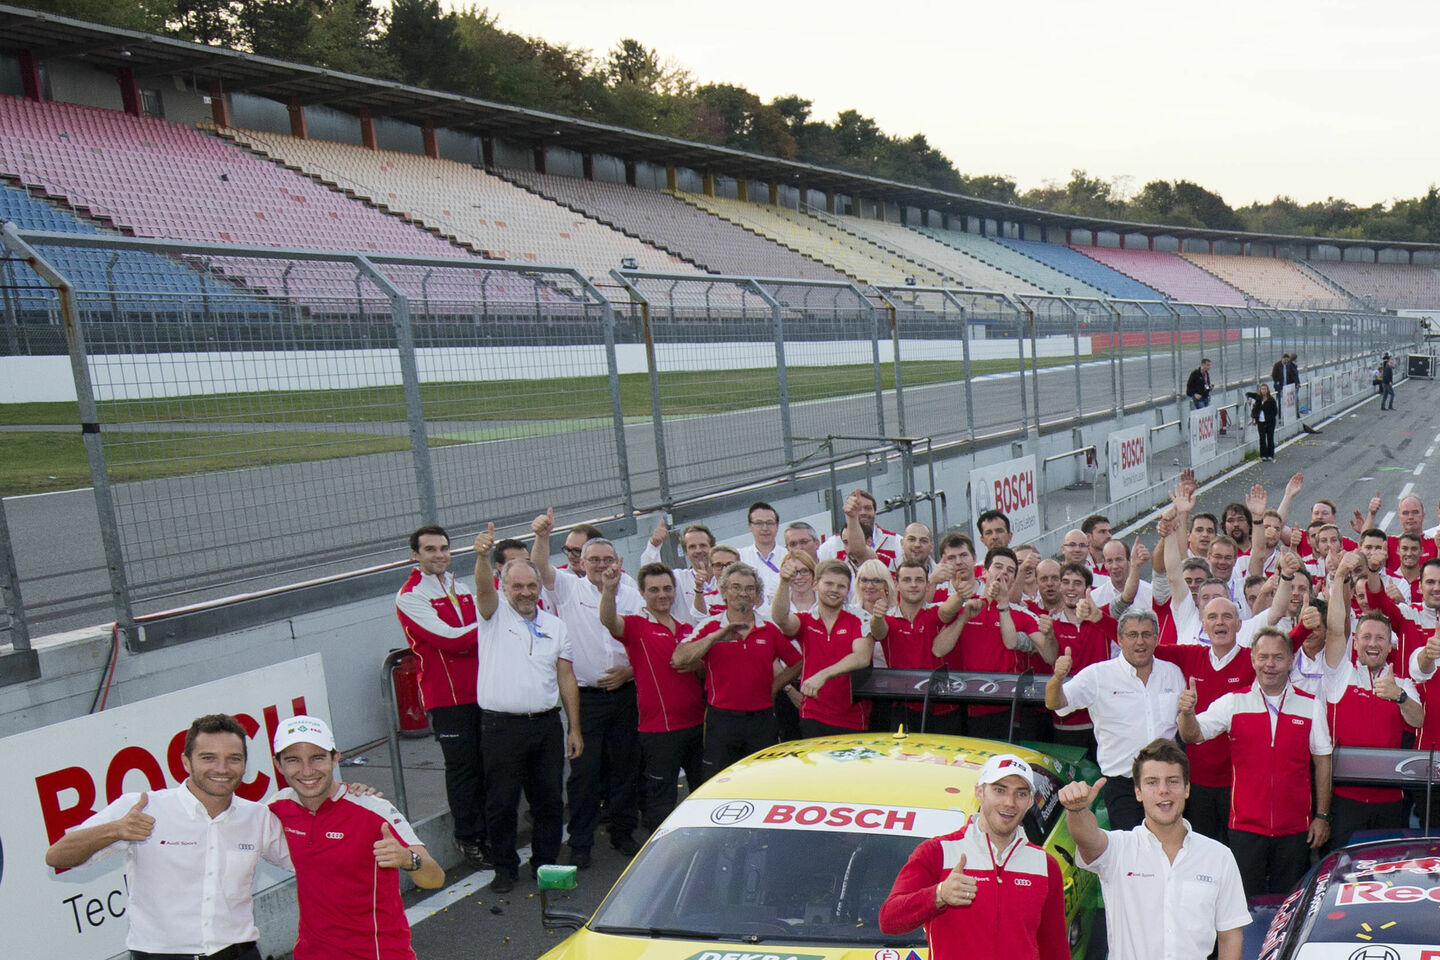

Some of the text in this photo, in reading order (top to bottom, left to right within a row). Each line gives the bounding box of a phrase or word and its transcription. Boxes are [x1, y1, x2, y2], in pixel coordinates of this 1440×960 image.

[1121, 436, 1145, 470] BOSCH
[994, 470, 1034, 514] BOSCH
[762, 804, 917, 831] BOSCH
